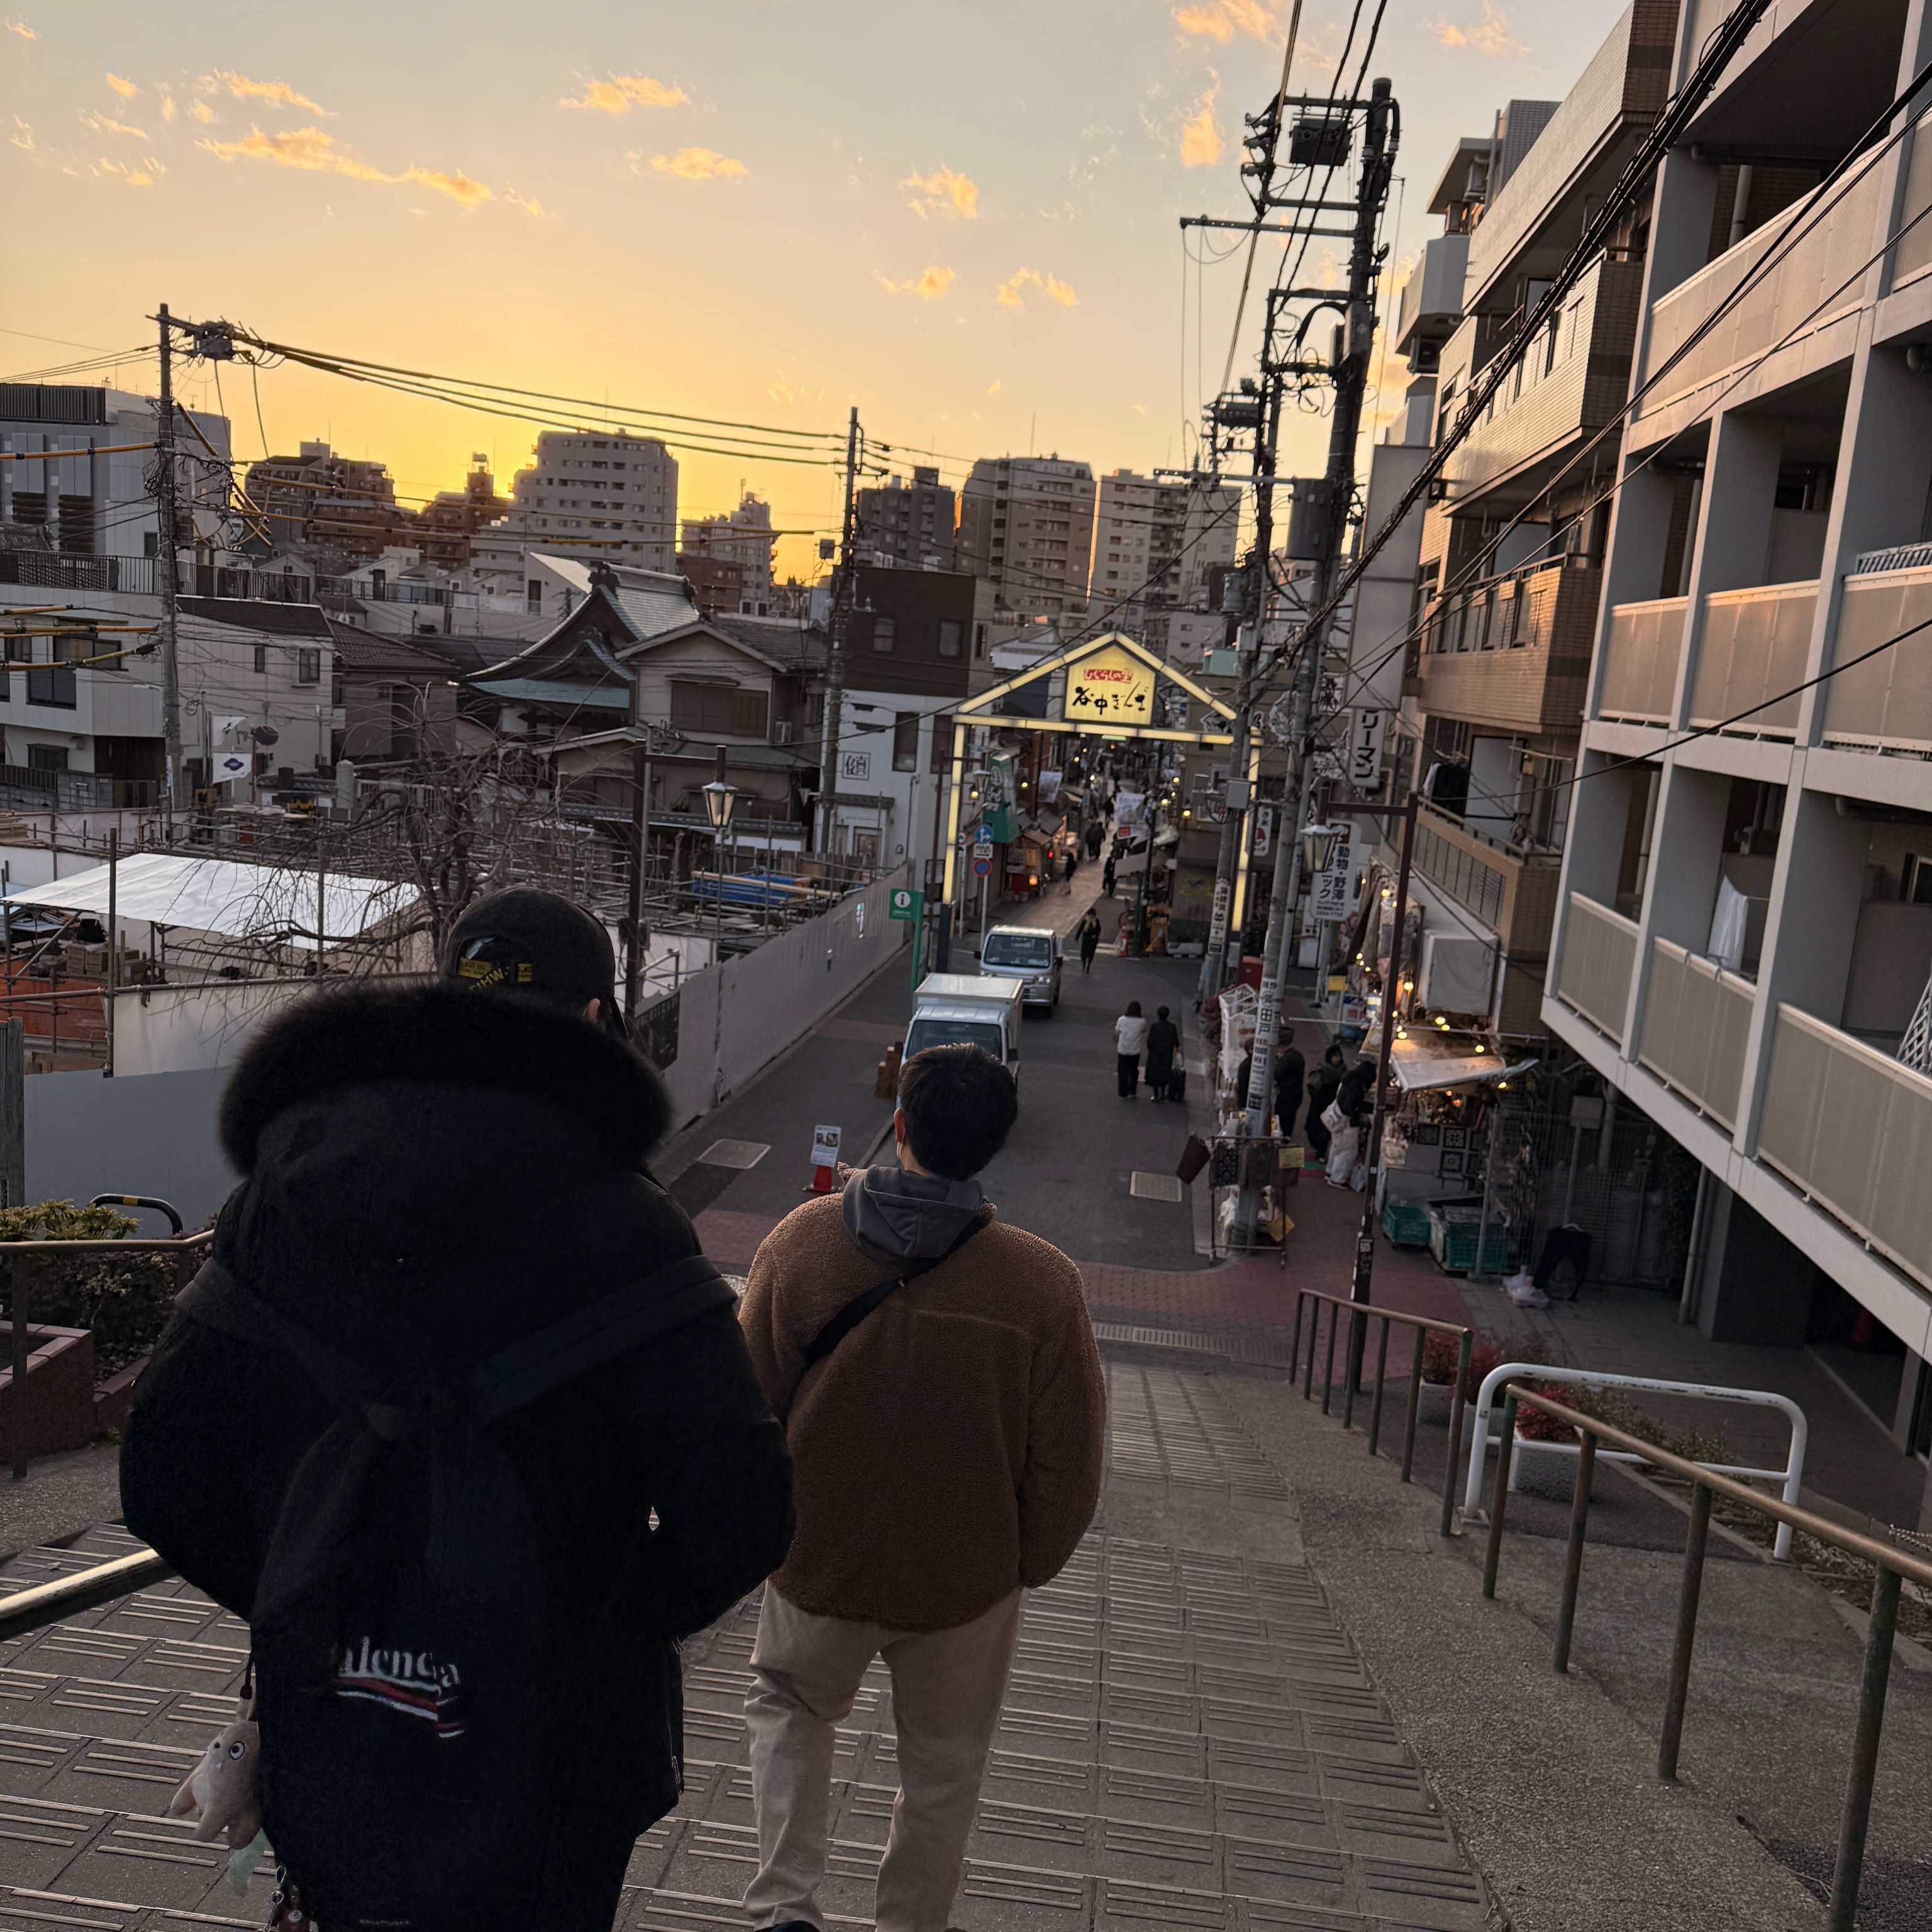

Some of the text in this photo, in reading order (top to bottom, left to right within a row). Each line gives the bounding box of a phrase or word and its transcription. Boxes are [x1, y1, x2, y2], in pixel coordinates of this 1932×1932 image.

[1072, 682, 1150, 715] 谷中ぎんざ
